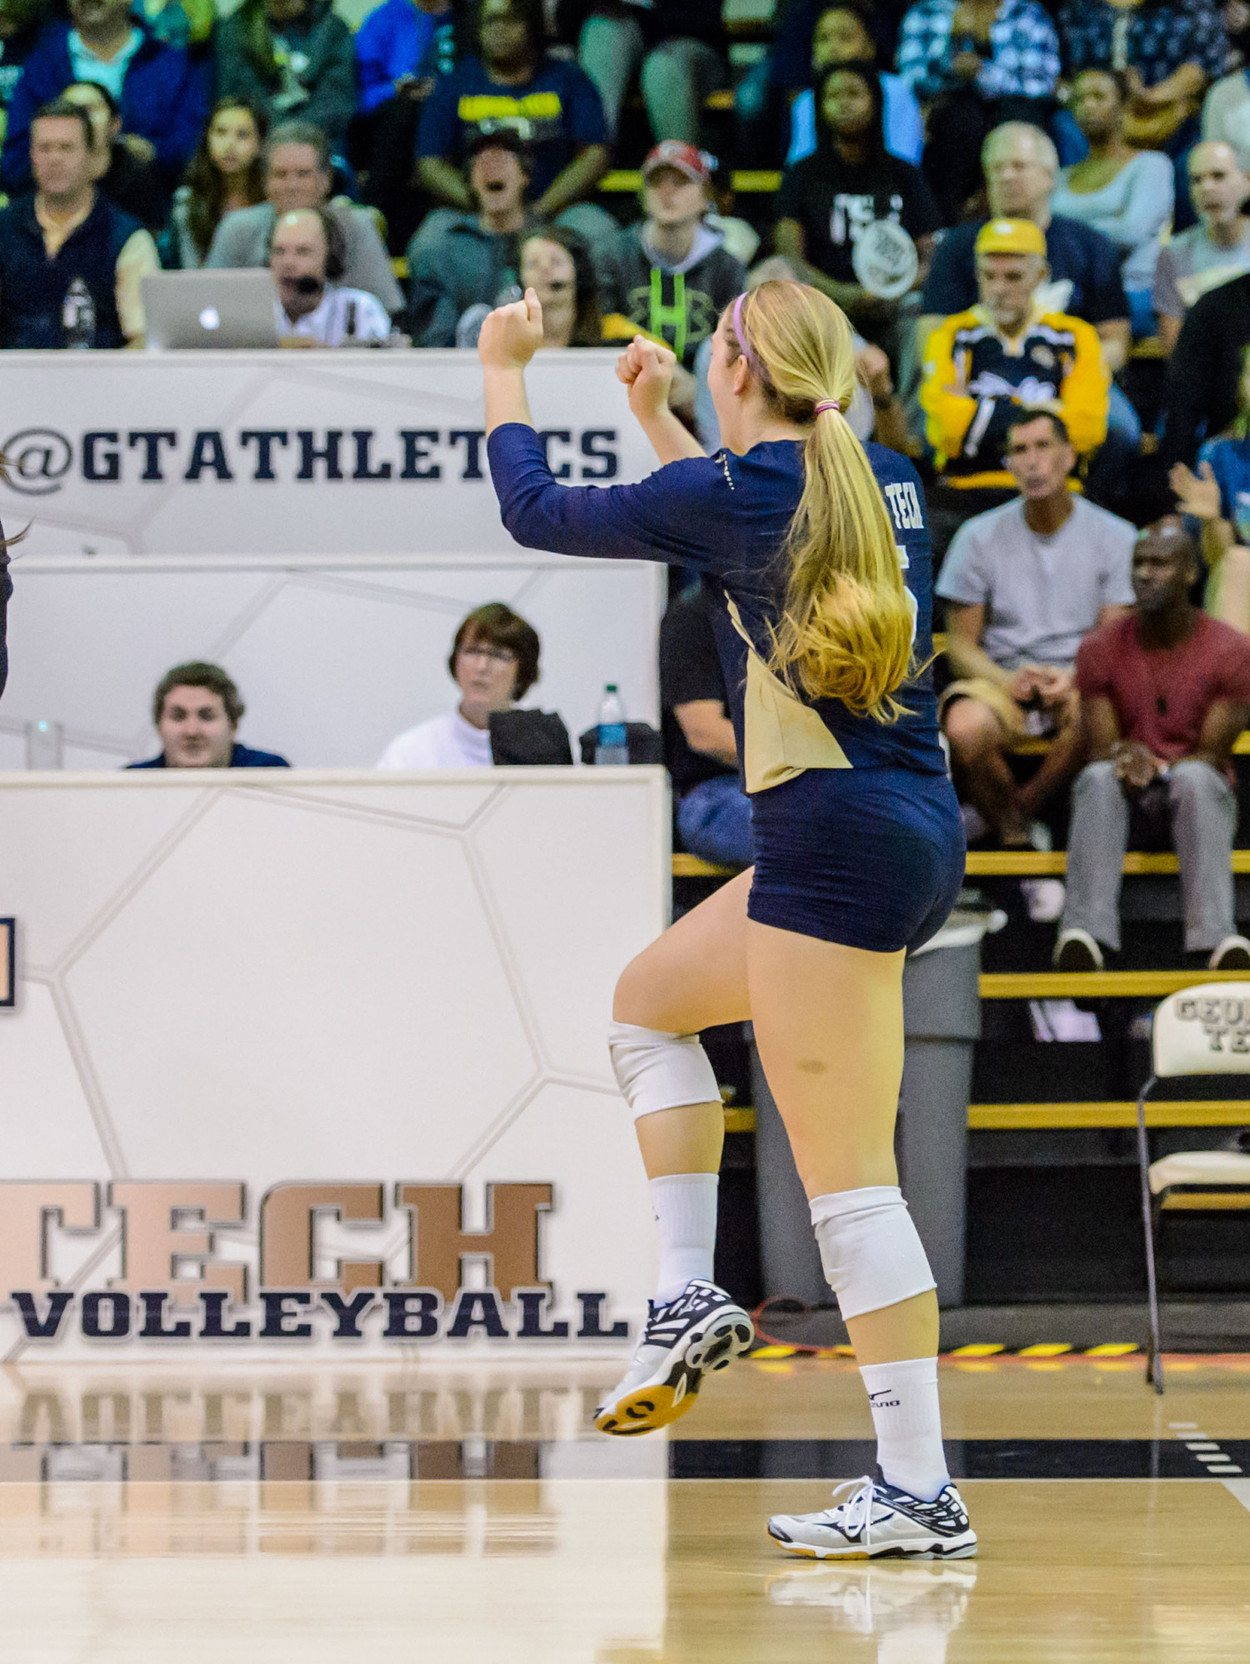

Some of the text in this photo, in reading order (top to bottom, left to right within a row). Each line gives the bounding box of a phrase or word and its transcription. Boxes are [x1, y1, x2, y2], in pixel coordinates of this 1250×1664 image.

[0, 428, 618, 496] @GTATHLETCS
[0, 1182, 554, 1310] TECH
[10, 1292, 629, 1337] VOLLEYBALL
